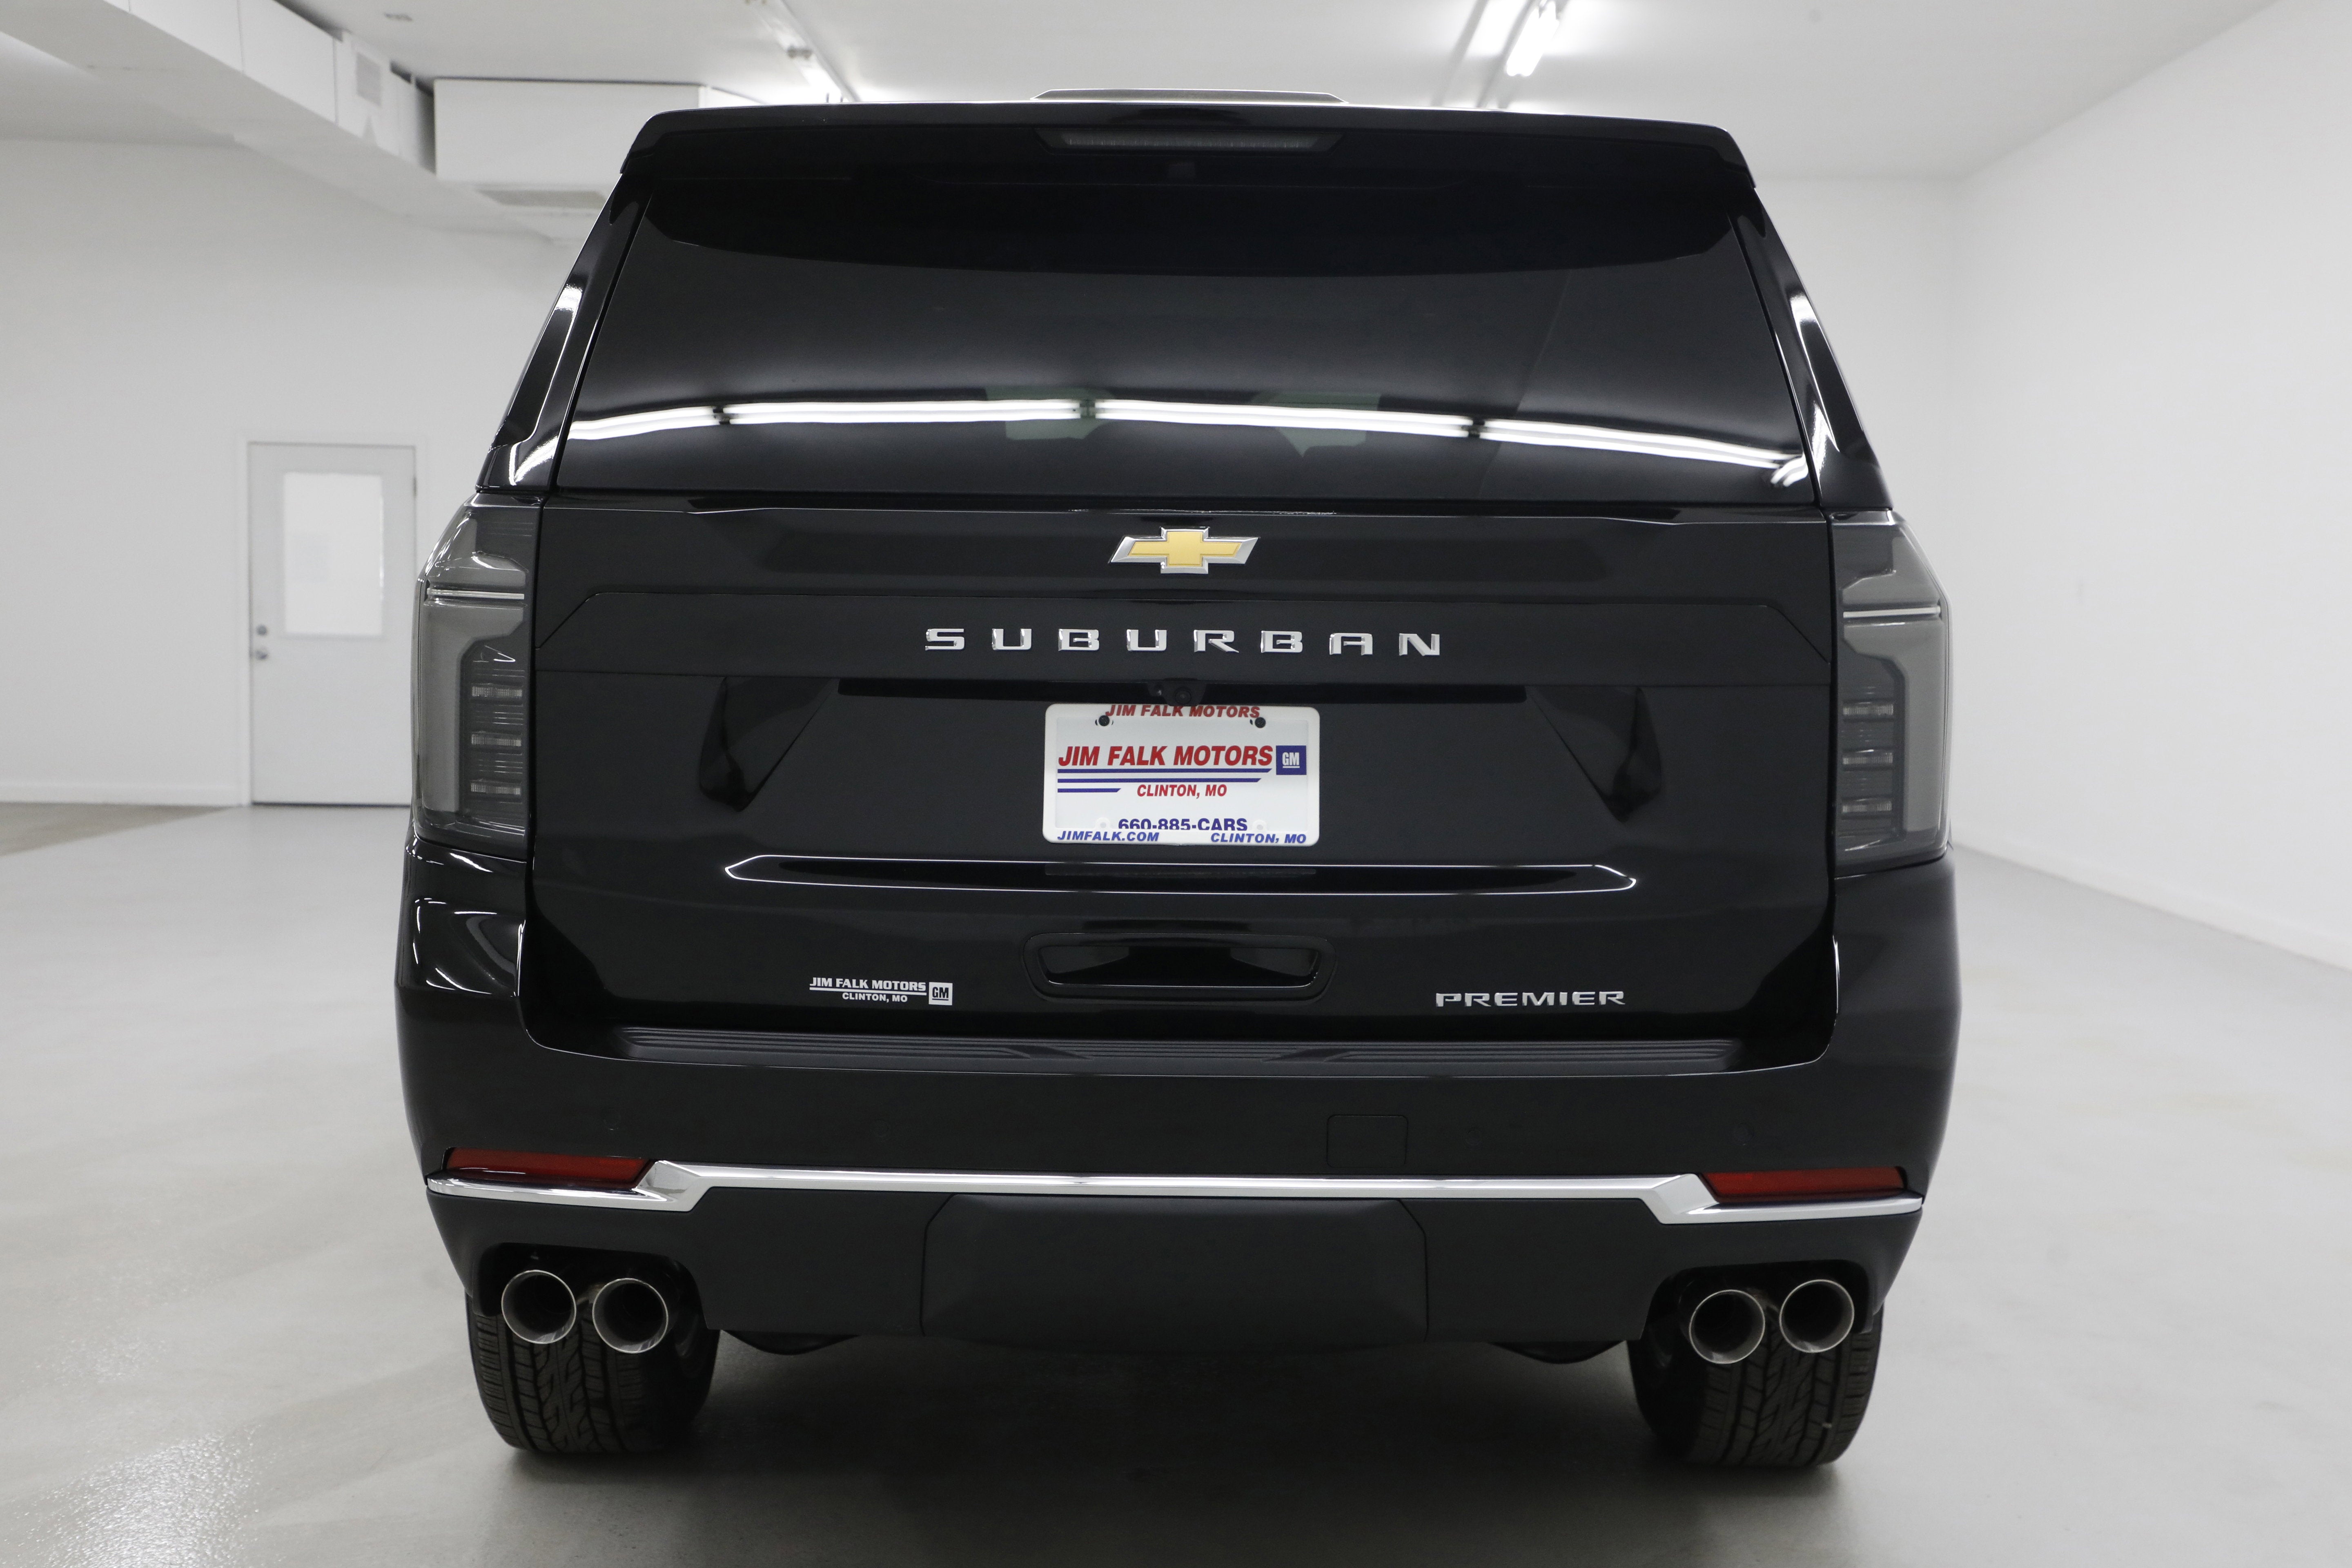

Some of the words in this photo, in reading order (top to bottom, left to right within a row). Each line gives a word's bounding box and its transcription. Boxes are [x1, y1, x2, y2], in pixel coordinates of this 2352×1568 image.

[925, 628, 1441, 656] SUBURBAN
[1105, 704, 1136, 717] JIM
[1140, 705, 1184, 717] FALK
[1189, 706, 1260, 718] MOTORS
[1058, 746, 1100, 766] JIM
[1107, 746, 1167, 766] FALK
[1174, 746, 1273, 766] MOTORS
[1282, 752, 1300, 766] GM
[1137, 784, 1200, 799] CLINTON,
[1205, 784, 1227, 797] MO
[1118, 818, 1248, 831] 660-885-CARS
[1057, 831, 1159, 842] JIMFALK.COM
[1211, 833, 1279, 844] CLINTON,
[1284, 834, 1307, 844] MO
[809, 977, 832, 987] JIM
[835, 978, 869, 989] FALK
[872, 980, 927, 991] MOTORS
[842, 992, 889, 1002] CLINTON,
[932, 987, 949, 998] GM
[1436, 991, 1626, 1007] PREMIER
